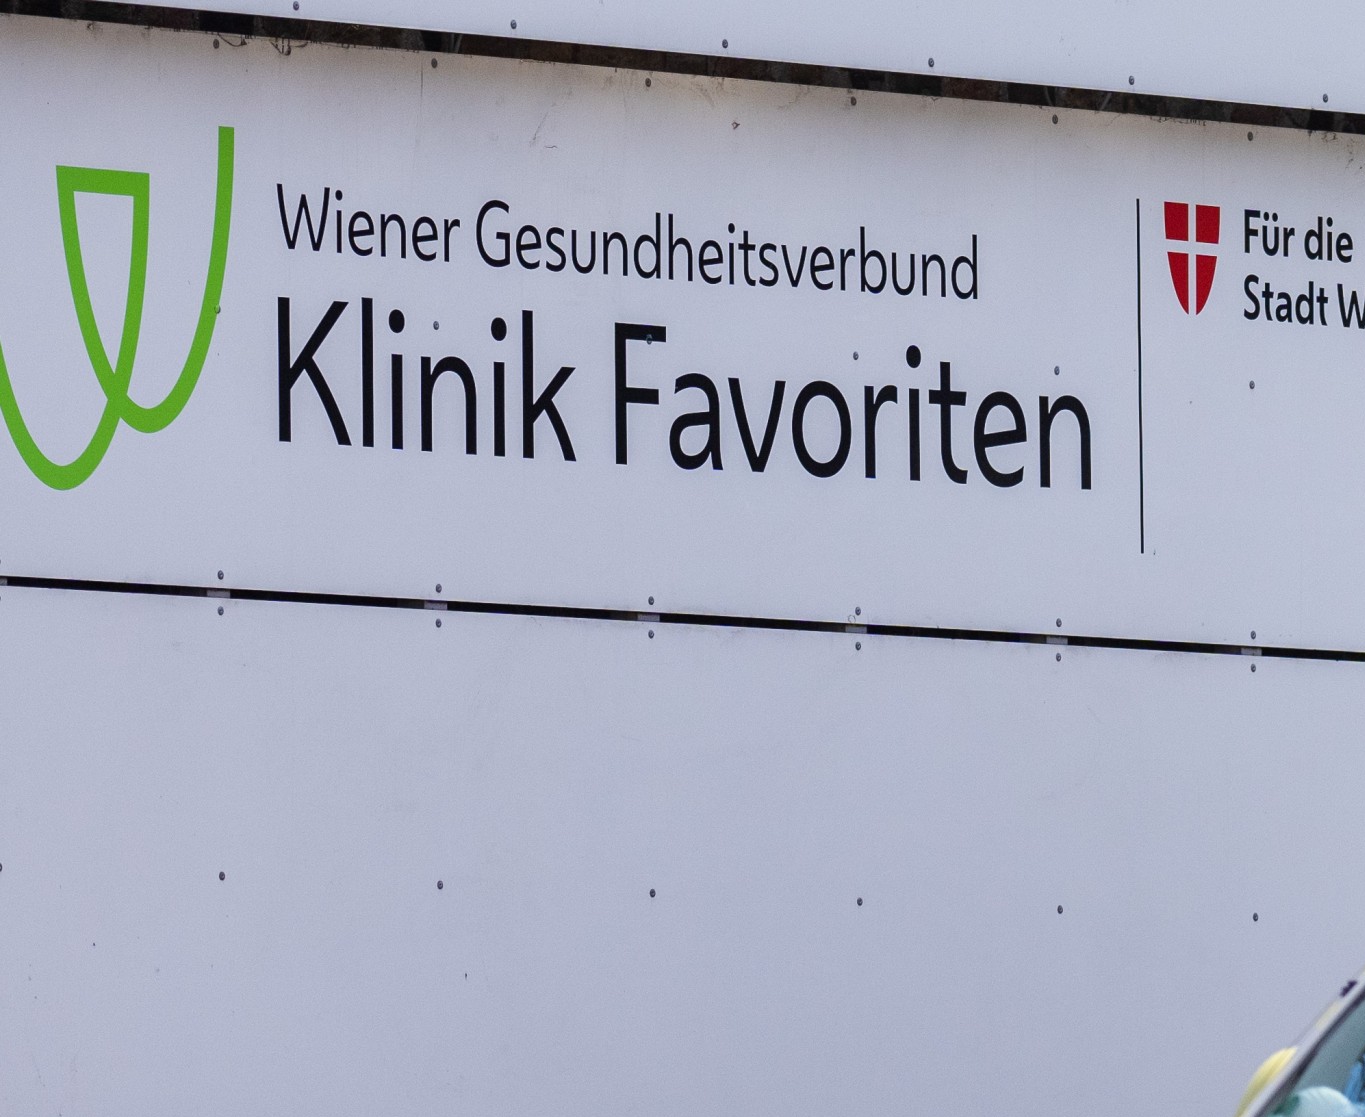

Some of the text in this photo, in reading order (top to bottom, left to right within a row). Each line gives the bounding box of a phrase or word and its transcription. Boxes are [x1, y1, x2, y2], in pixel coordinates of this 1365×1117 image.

[276, 183, 978, 300] Wiener Gesundheitsverbund
[1244, 208, 1354, 264] Für die
[1243, 274, 1329, 326] Stadt
[277, 296, 1092, 490] Klinik Favoriten
